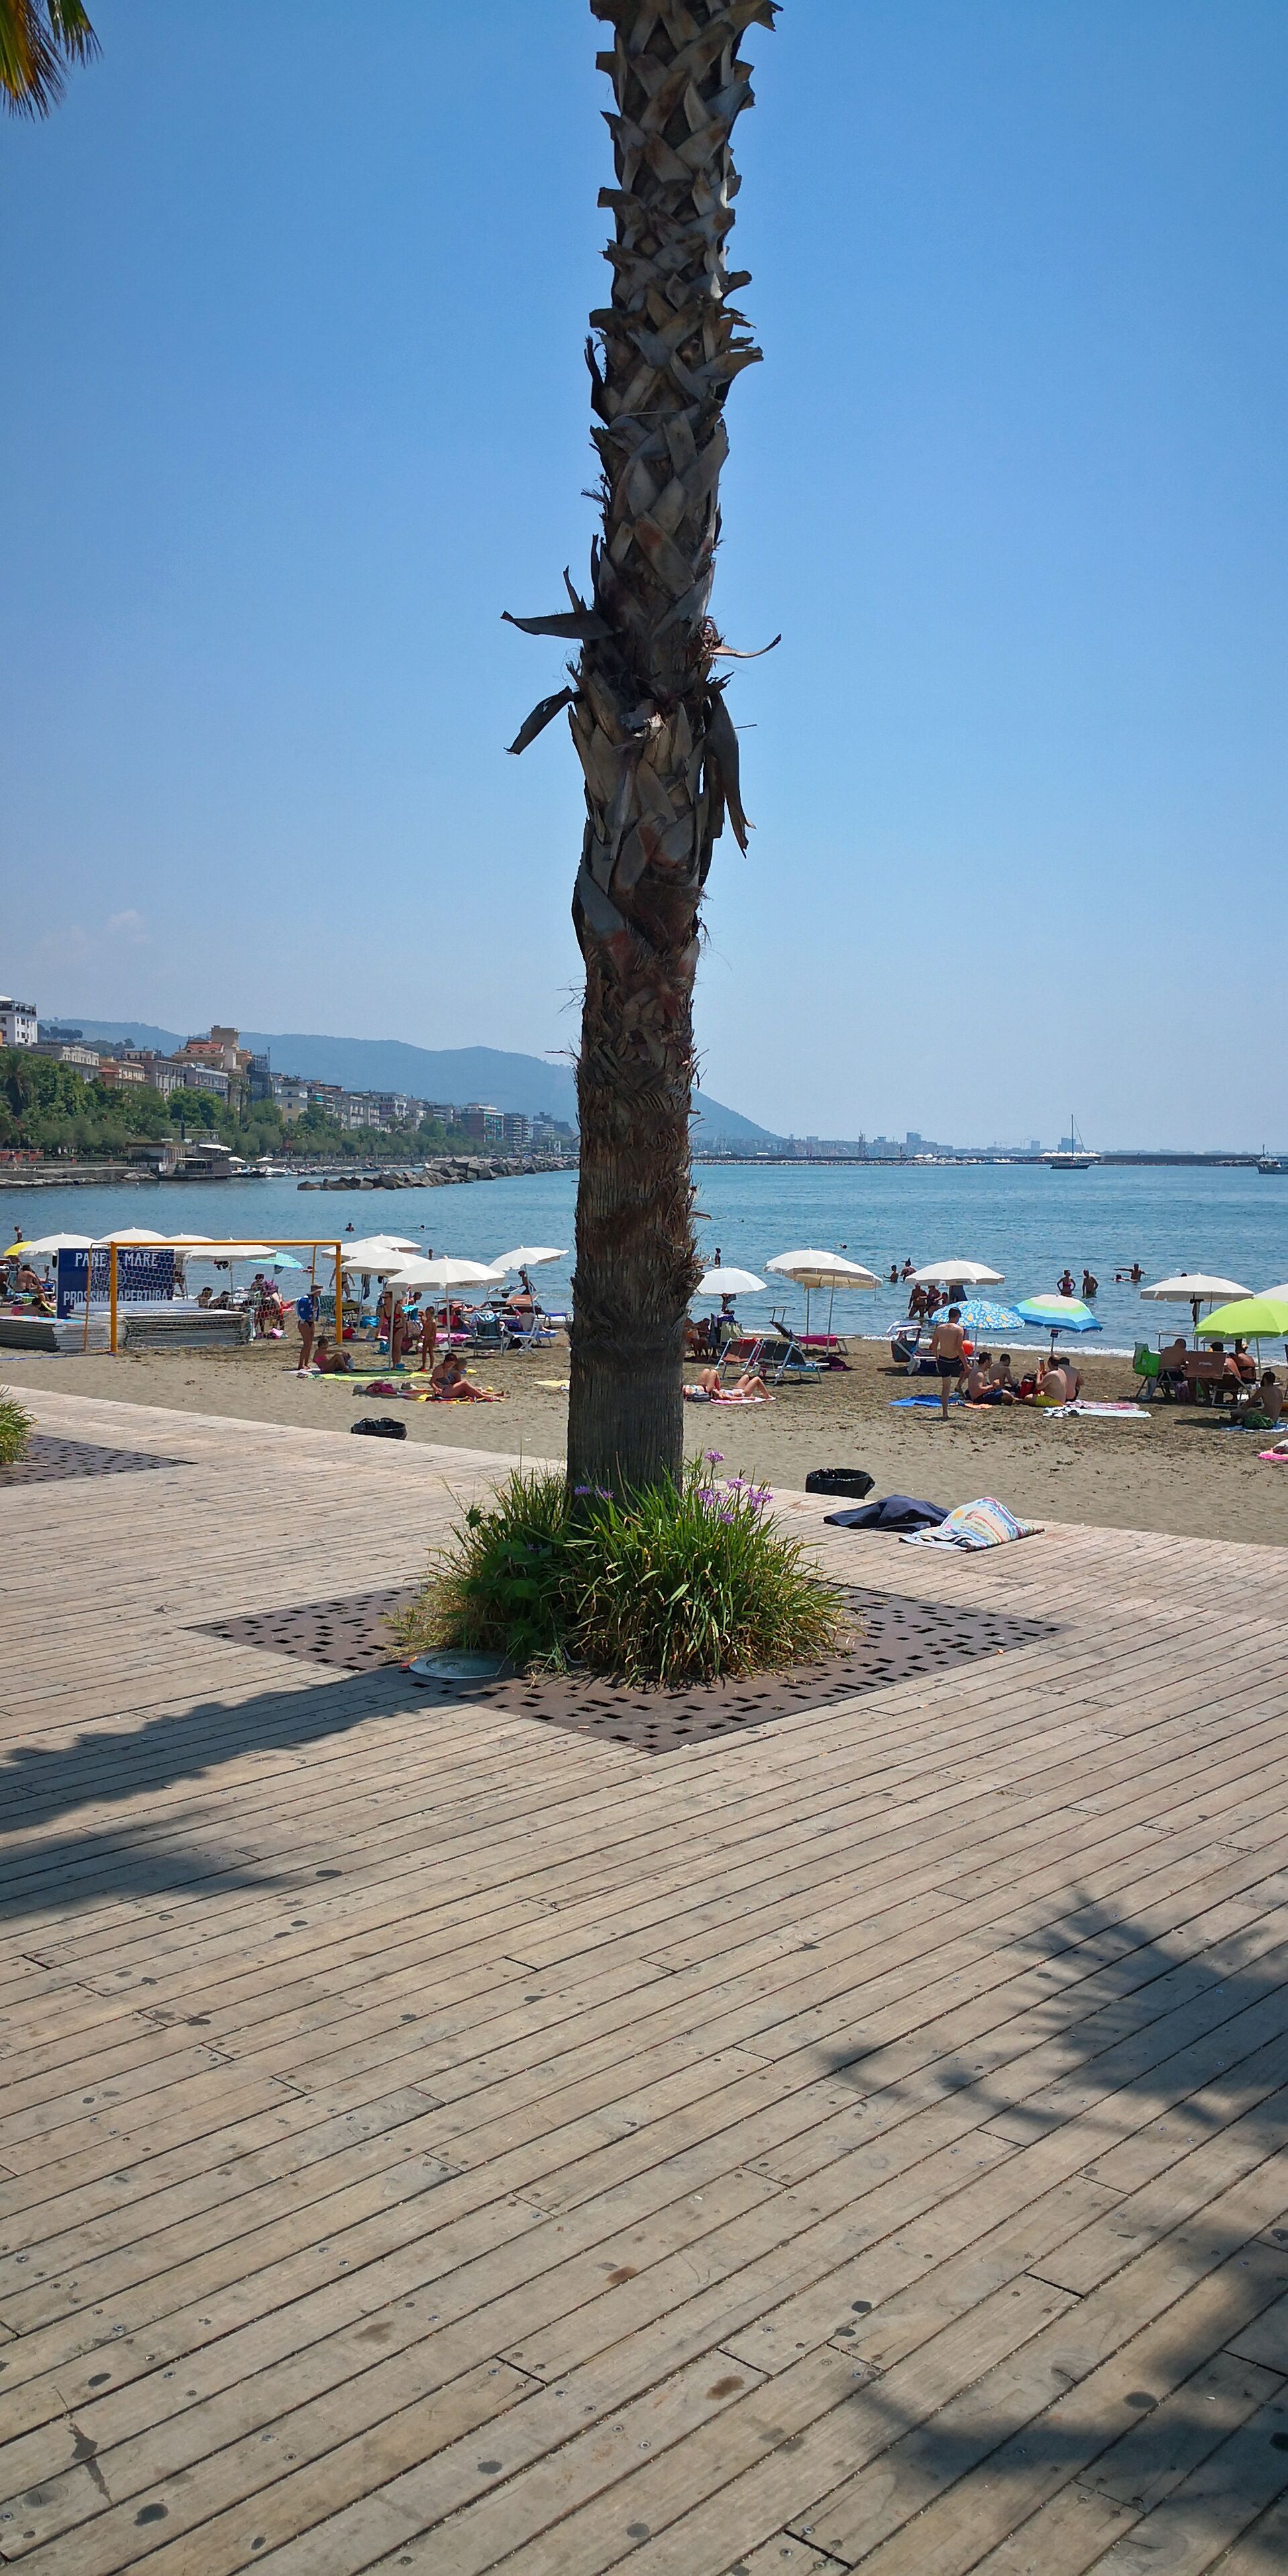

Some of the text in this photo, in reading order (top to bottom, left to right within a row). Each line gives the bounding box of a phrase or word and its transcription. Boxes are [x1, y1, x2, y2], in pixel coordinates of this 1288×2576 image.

[75, 1252, 107, 1267] PANE
[125, 1252, 158, 1267] MARE
[64, 1291, 111, 1305] PROSSIM
